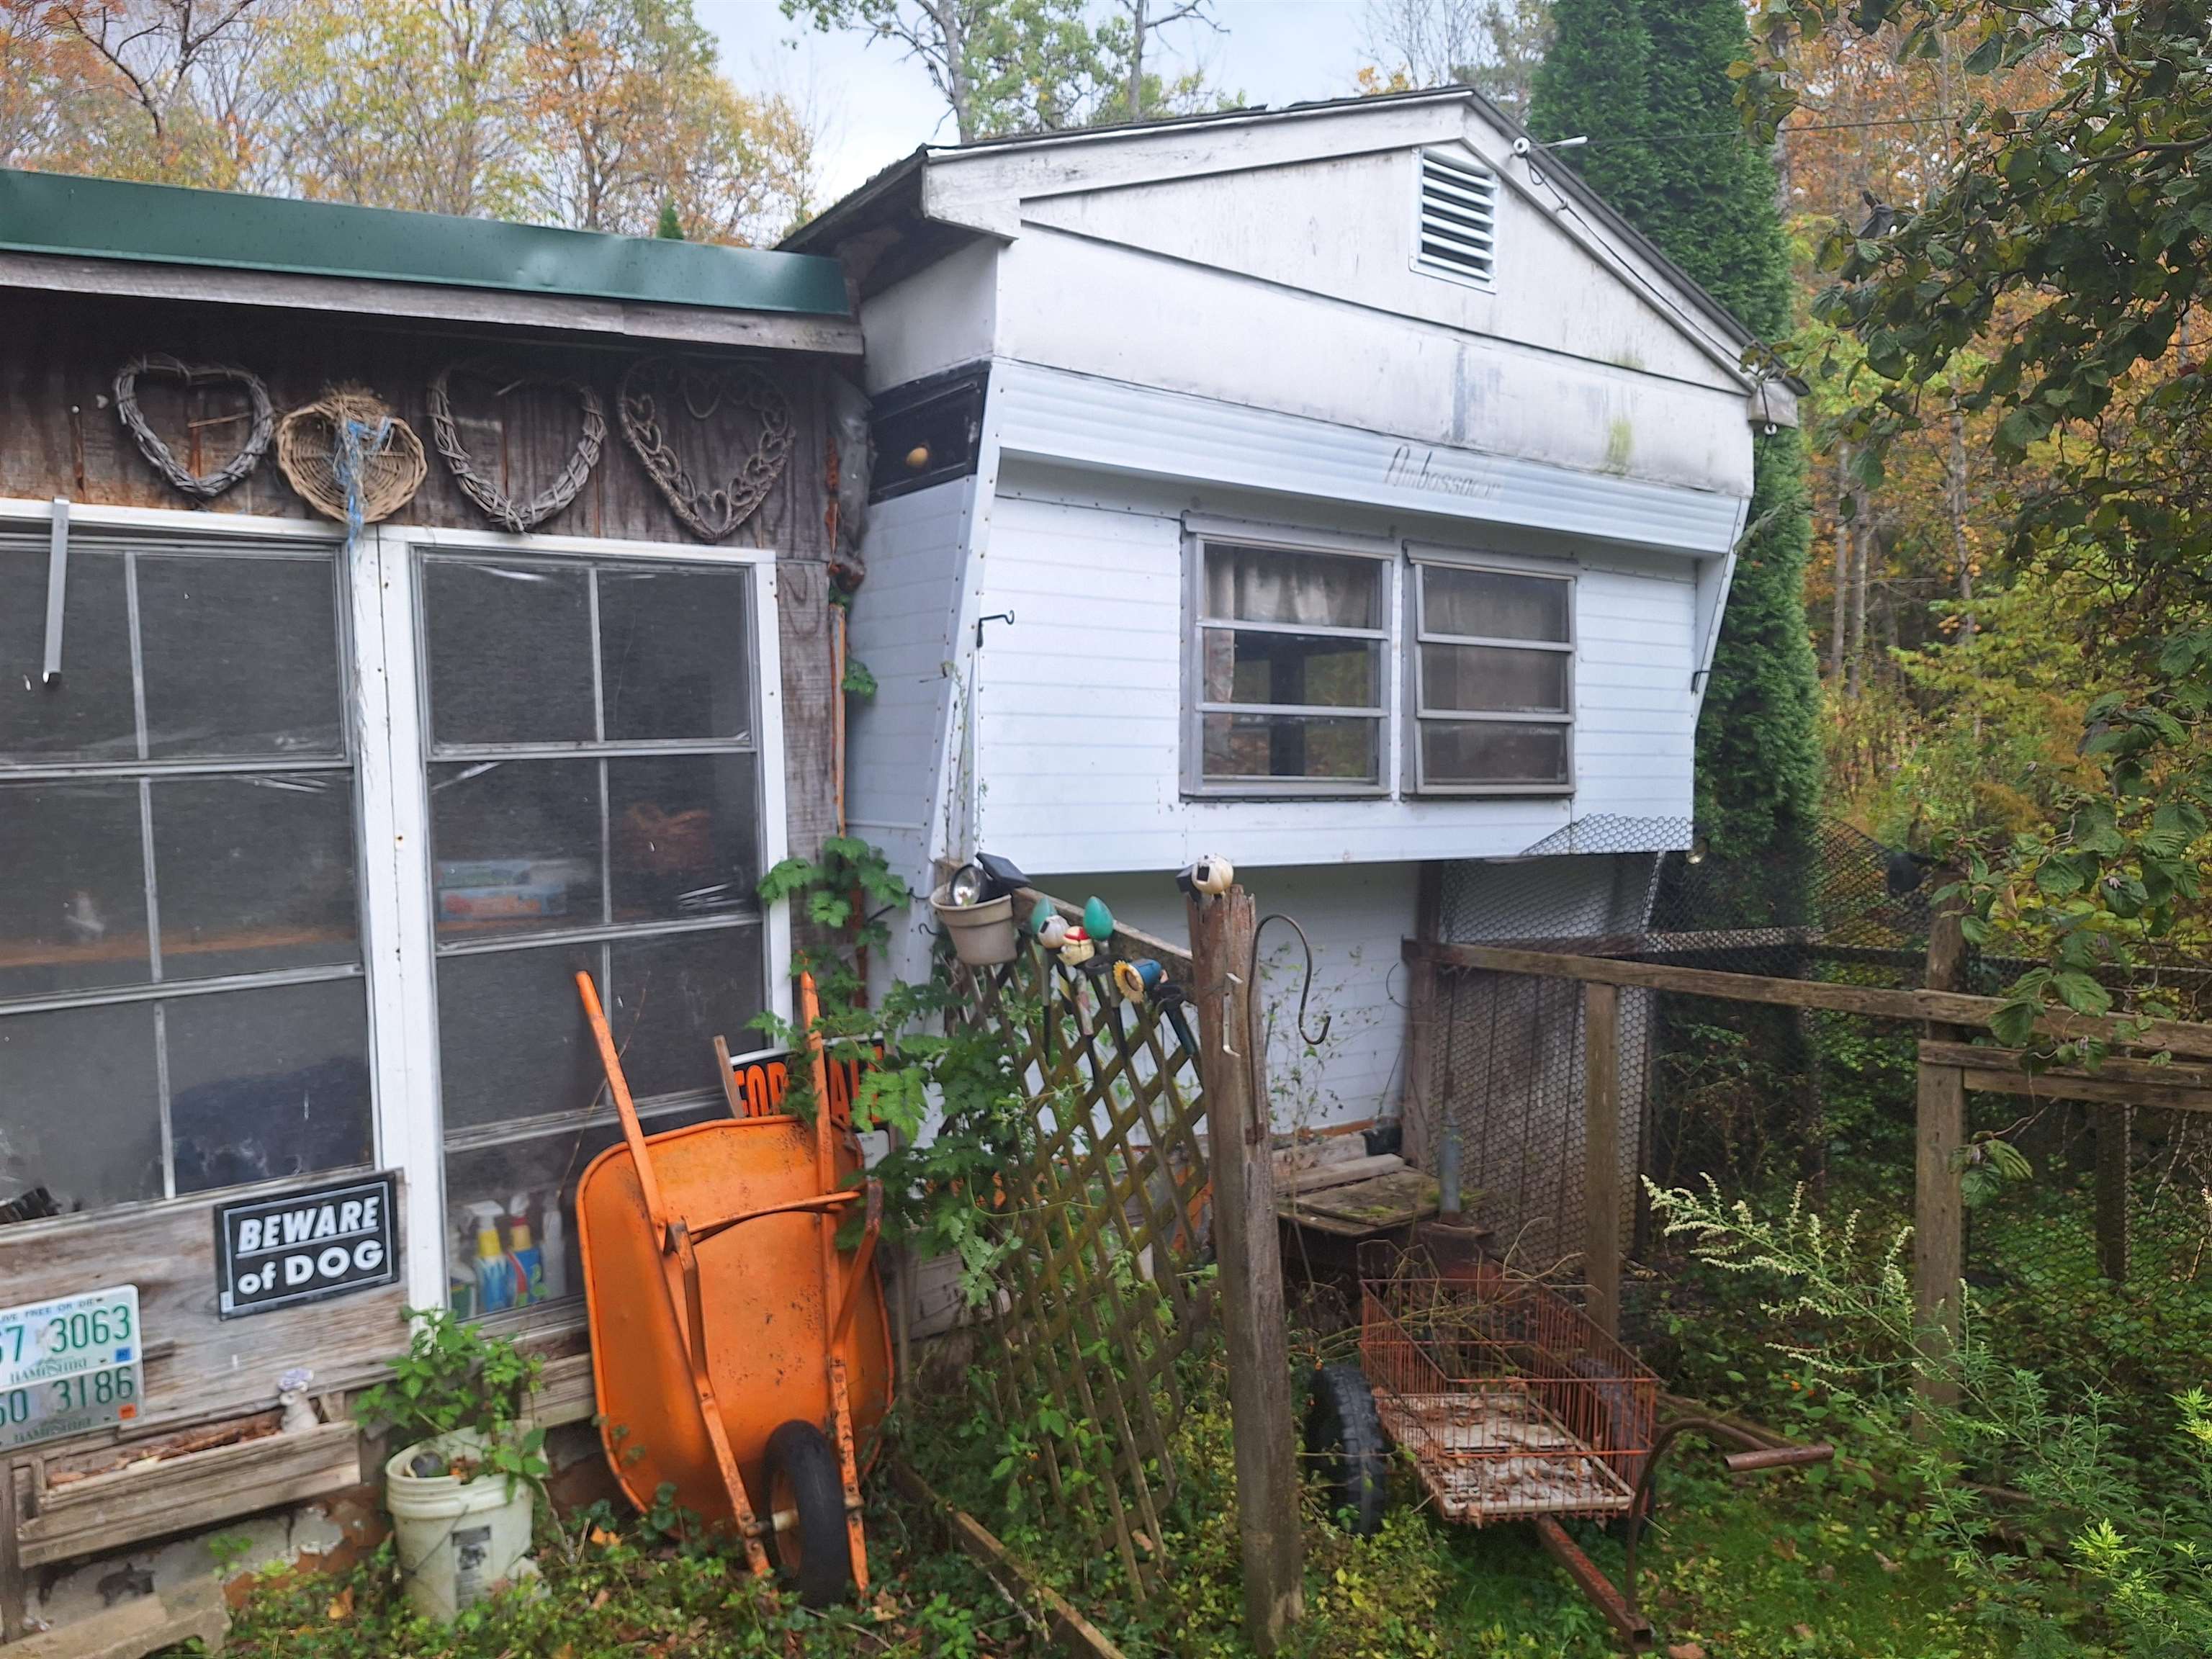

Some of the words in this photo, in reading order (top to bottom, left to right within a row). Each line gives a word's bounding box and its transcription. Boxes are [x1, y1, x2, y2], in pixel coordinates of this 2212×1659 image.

[238, 1195, 380, 1253] BEWARE
[238, 1261, 277, 1295] of
[284, 1239, 385, 1286] DOG
[0, 1325, 24, 1363] 7
[50, 1305, 131, 1353] 3063
[52, 1366, 133, 1413] 3186
